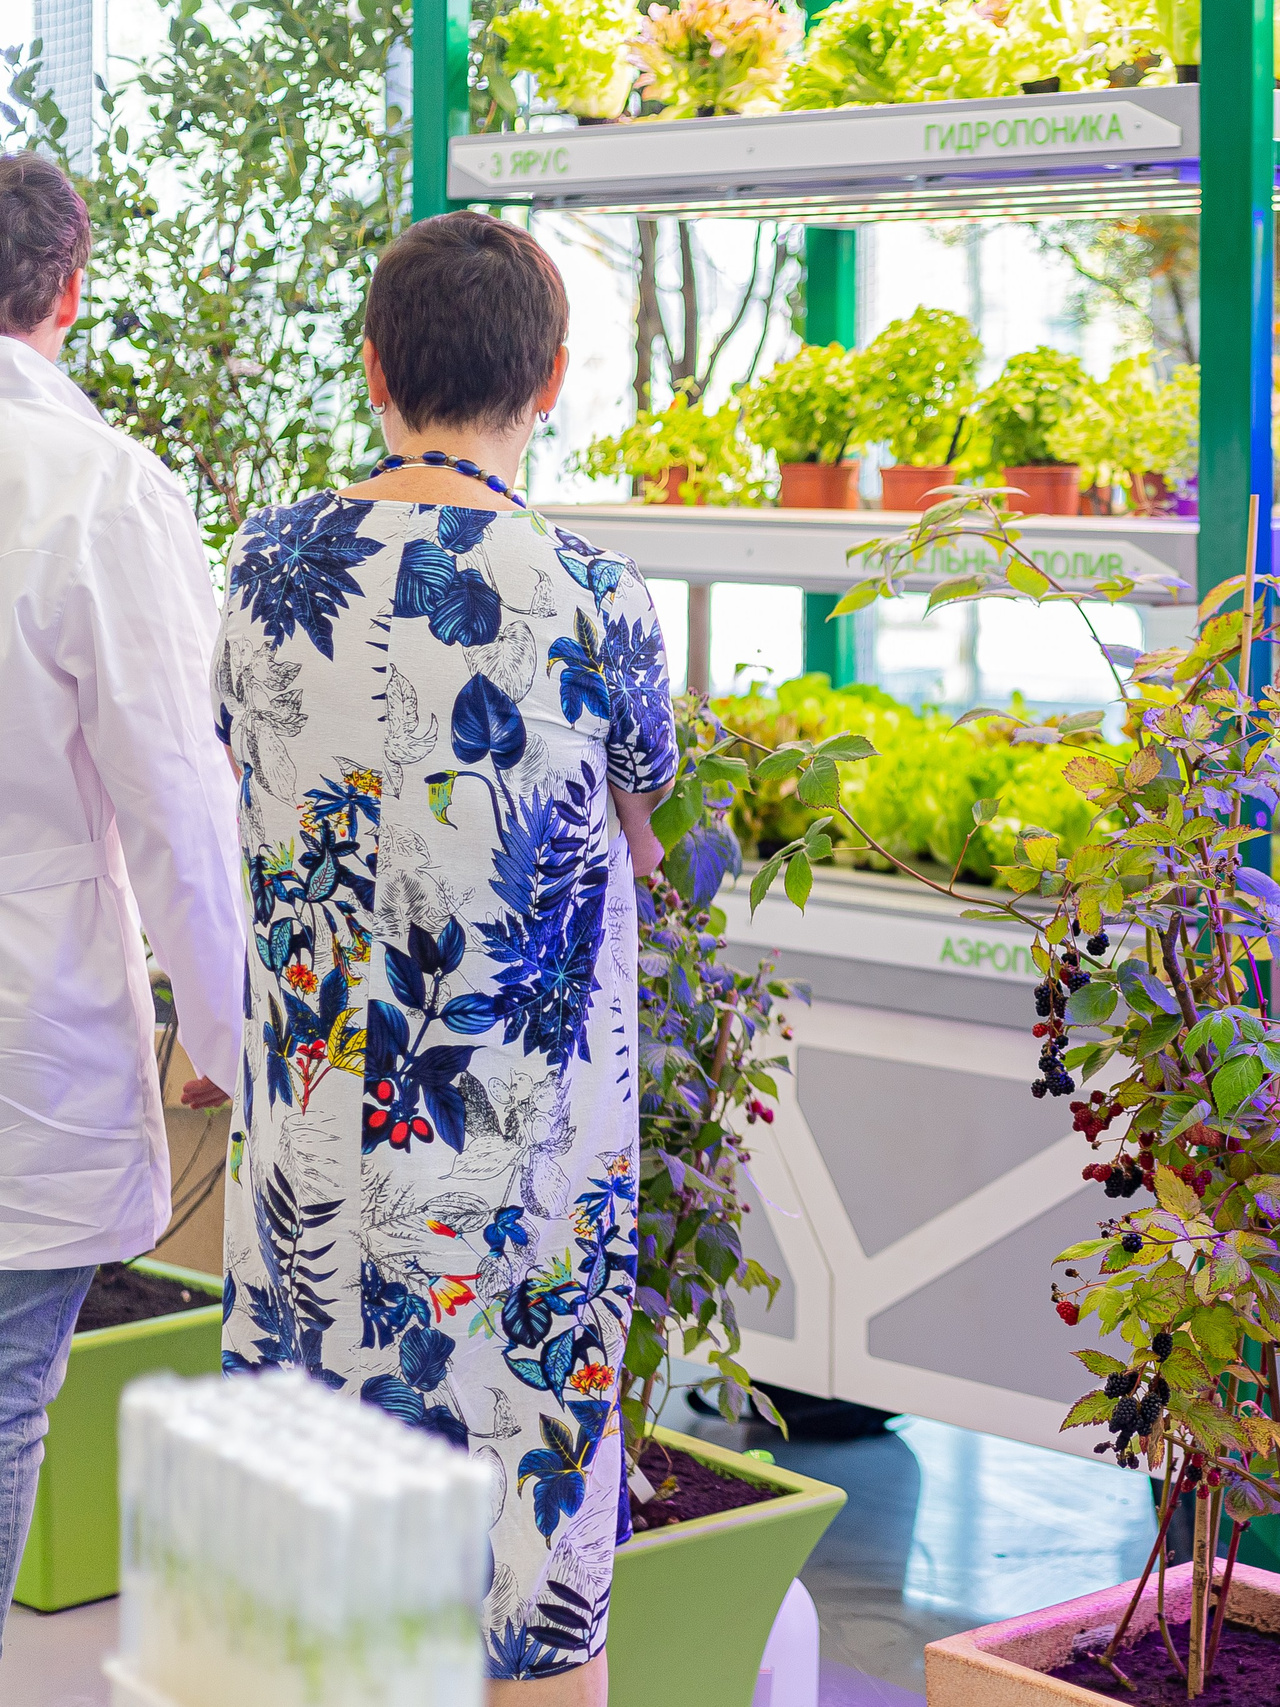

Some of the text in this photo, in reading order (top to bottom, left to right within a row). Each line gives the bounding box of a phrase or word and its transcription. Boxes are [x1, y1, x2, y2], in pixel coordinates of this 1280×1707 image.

[923, 112, 1124, 154] ГИДРОПОНИКА
[510, 146, 570, 176] ЯРУС
[1031, 550, 1124, 580] ПОЛИВ
